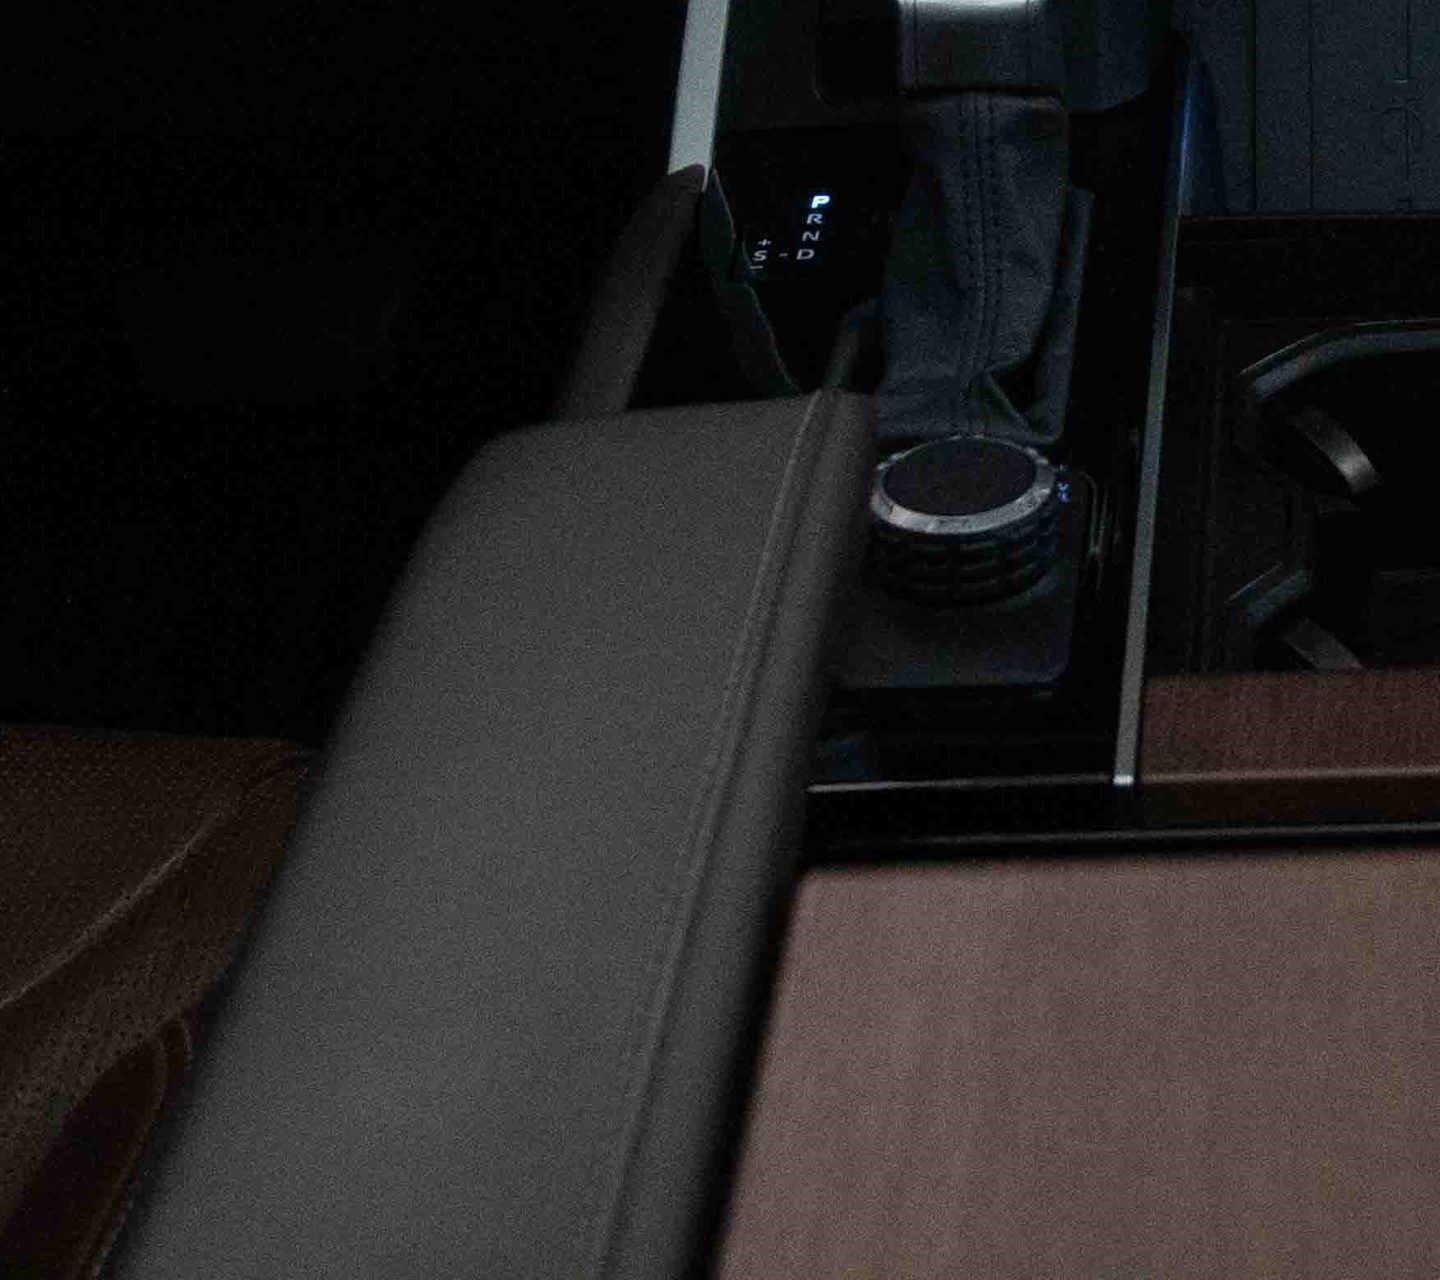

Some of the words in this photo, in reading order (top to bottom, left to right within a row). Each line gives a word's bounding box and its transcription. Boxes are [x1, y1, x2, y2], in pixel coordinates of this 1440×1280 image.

[811, 195, 831, 209] P
[806, 213, 824, 225] R
[802, 230, 820, 242] N
[752, 249, 768, 261] S
[796, 248, 816, 261] D
